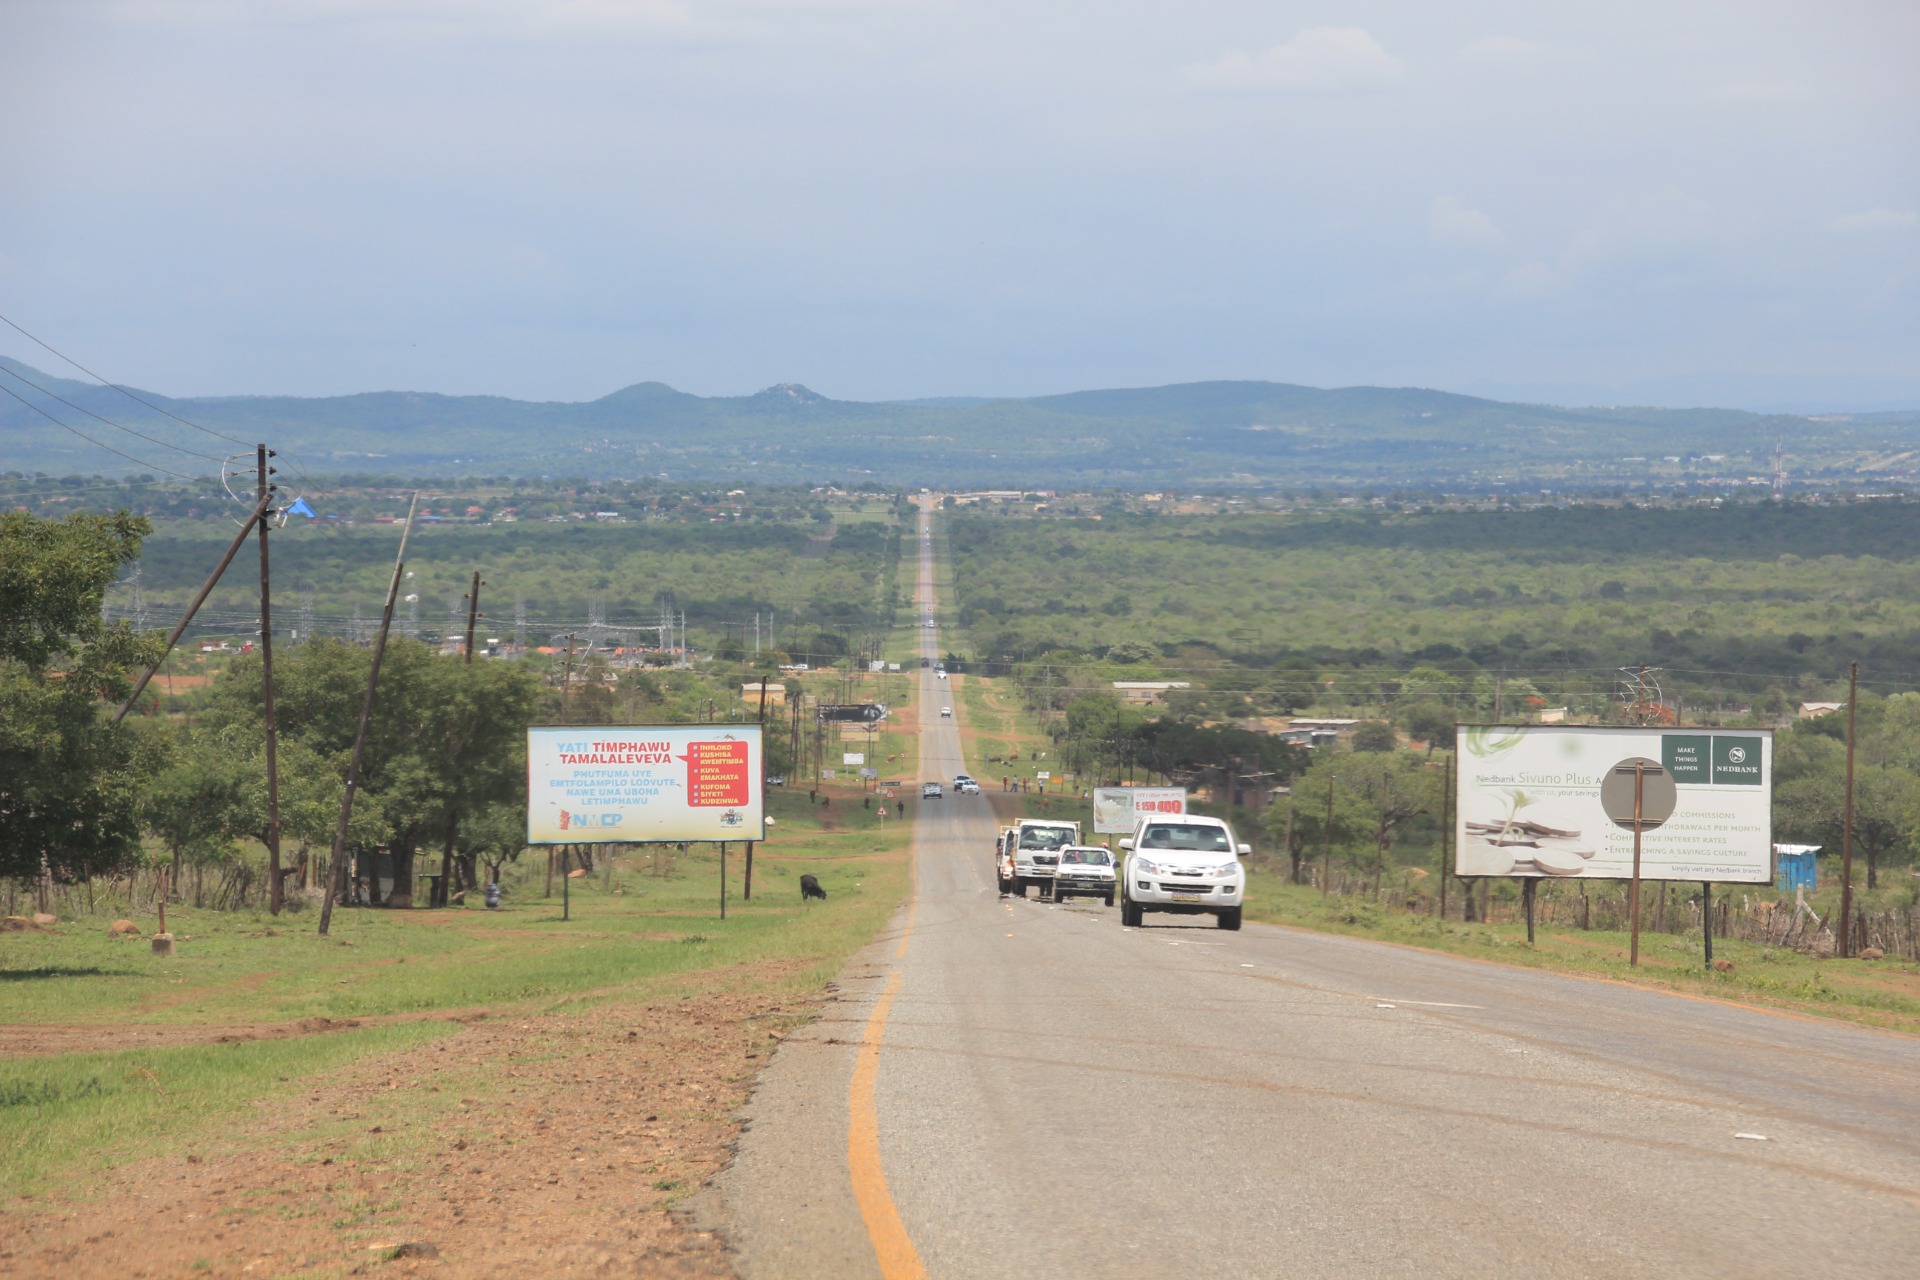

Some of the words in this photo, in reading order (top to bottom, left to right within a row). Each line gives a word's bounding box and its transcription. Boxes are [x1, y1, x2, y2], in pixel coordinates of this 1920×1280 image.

[557, 742, 588, 752] YATI
[593, 742, 670, 752] TIMPHAWU
[560, 754, 672, 764] TAMALALEVEVA
[573, 770, 629, 778] PHUTFUMA
[1476, 775, 1515, 783] Nedbank
[1518, 772, 1561, 784] Sivuno
[1566, 773, 1591, 784] Plus
[550, 779, 627, 787] EMTFOLAMPILO
[566, 788, 596, 796] NAWE
[599, 788, 621, 796] UMA
[1575, 790, 1599, 798] savings
[1610, 833, 1661, 842] COMPITIVE
[1610, 846, 1666, 855] ENTRECHING
[1677, 848, 1711, 856] SAVINGS
